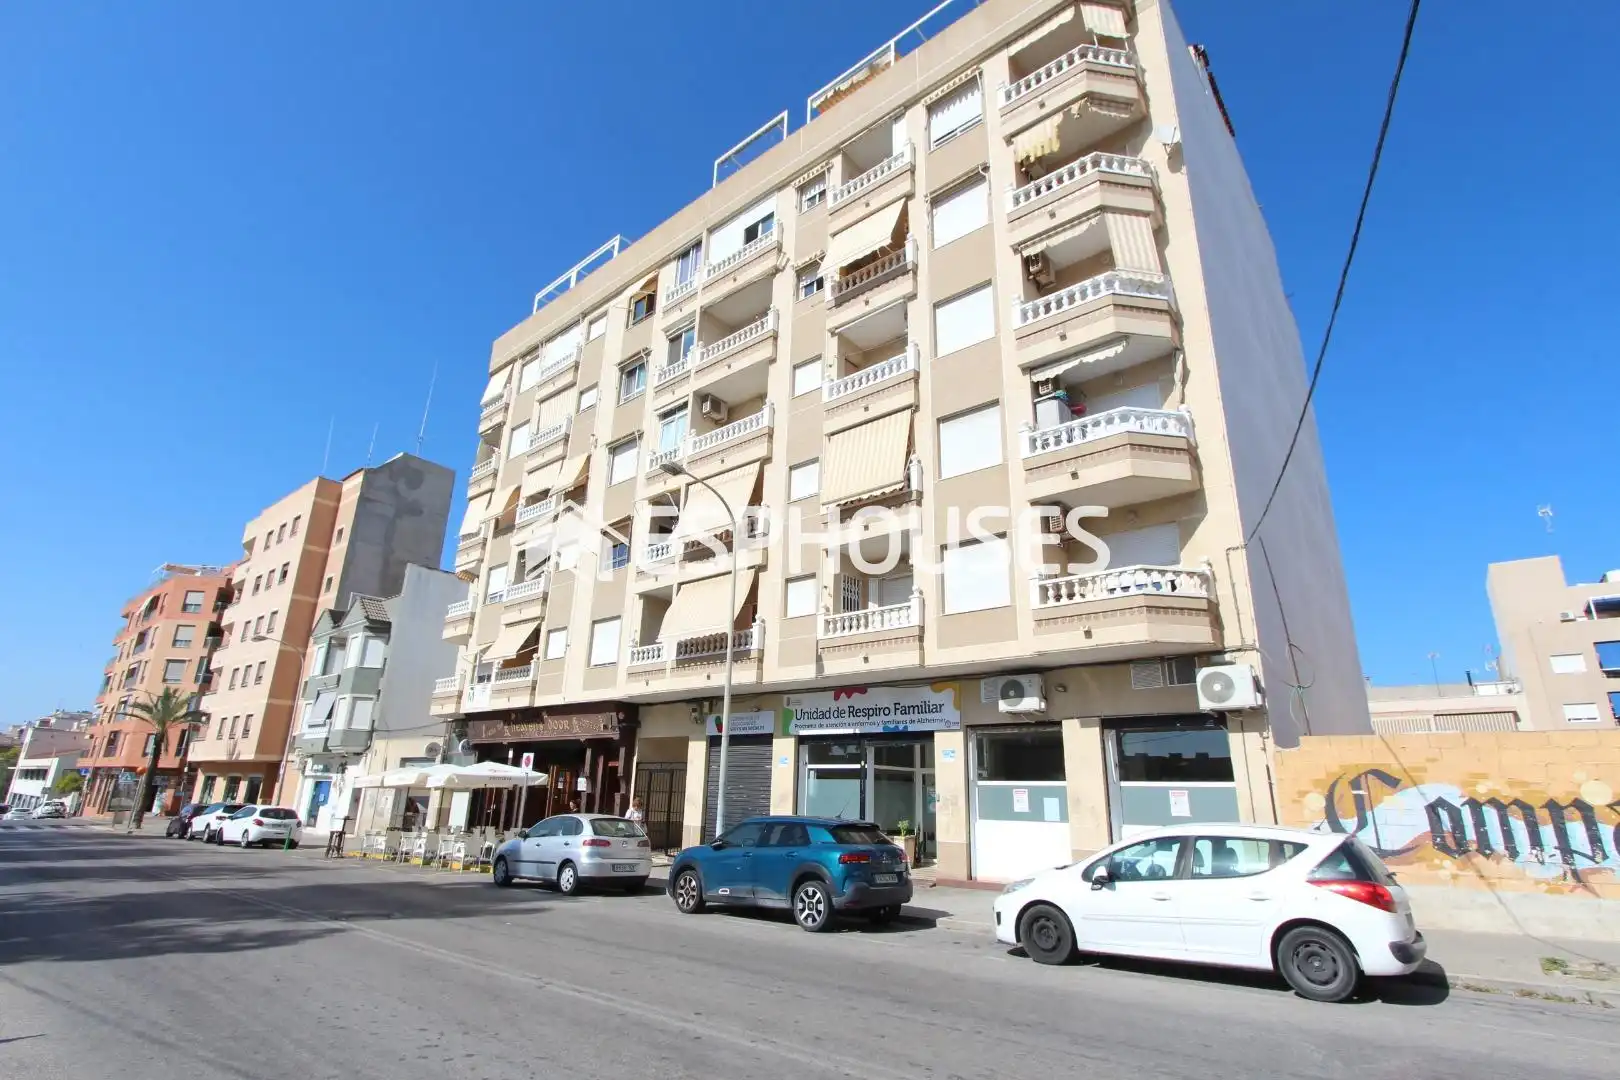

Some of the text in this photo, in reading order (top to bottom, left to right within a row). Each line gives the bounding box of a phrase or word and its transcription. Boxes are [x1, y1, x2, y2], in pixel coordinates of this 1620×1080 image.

[795, 700, 945, 721] Unidad de Respiro Familiar
[881, 718, 908, 726] familiares
[916, 717, 946, 725] Alzheimer
